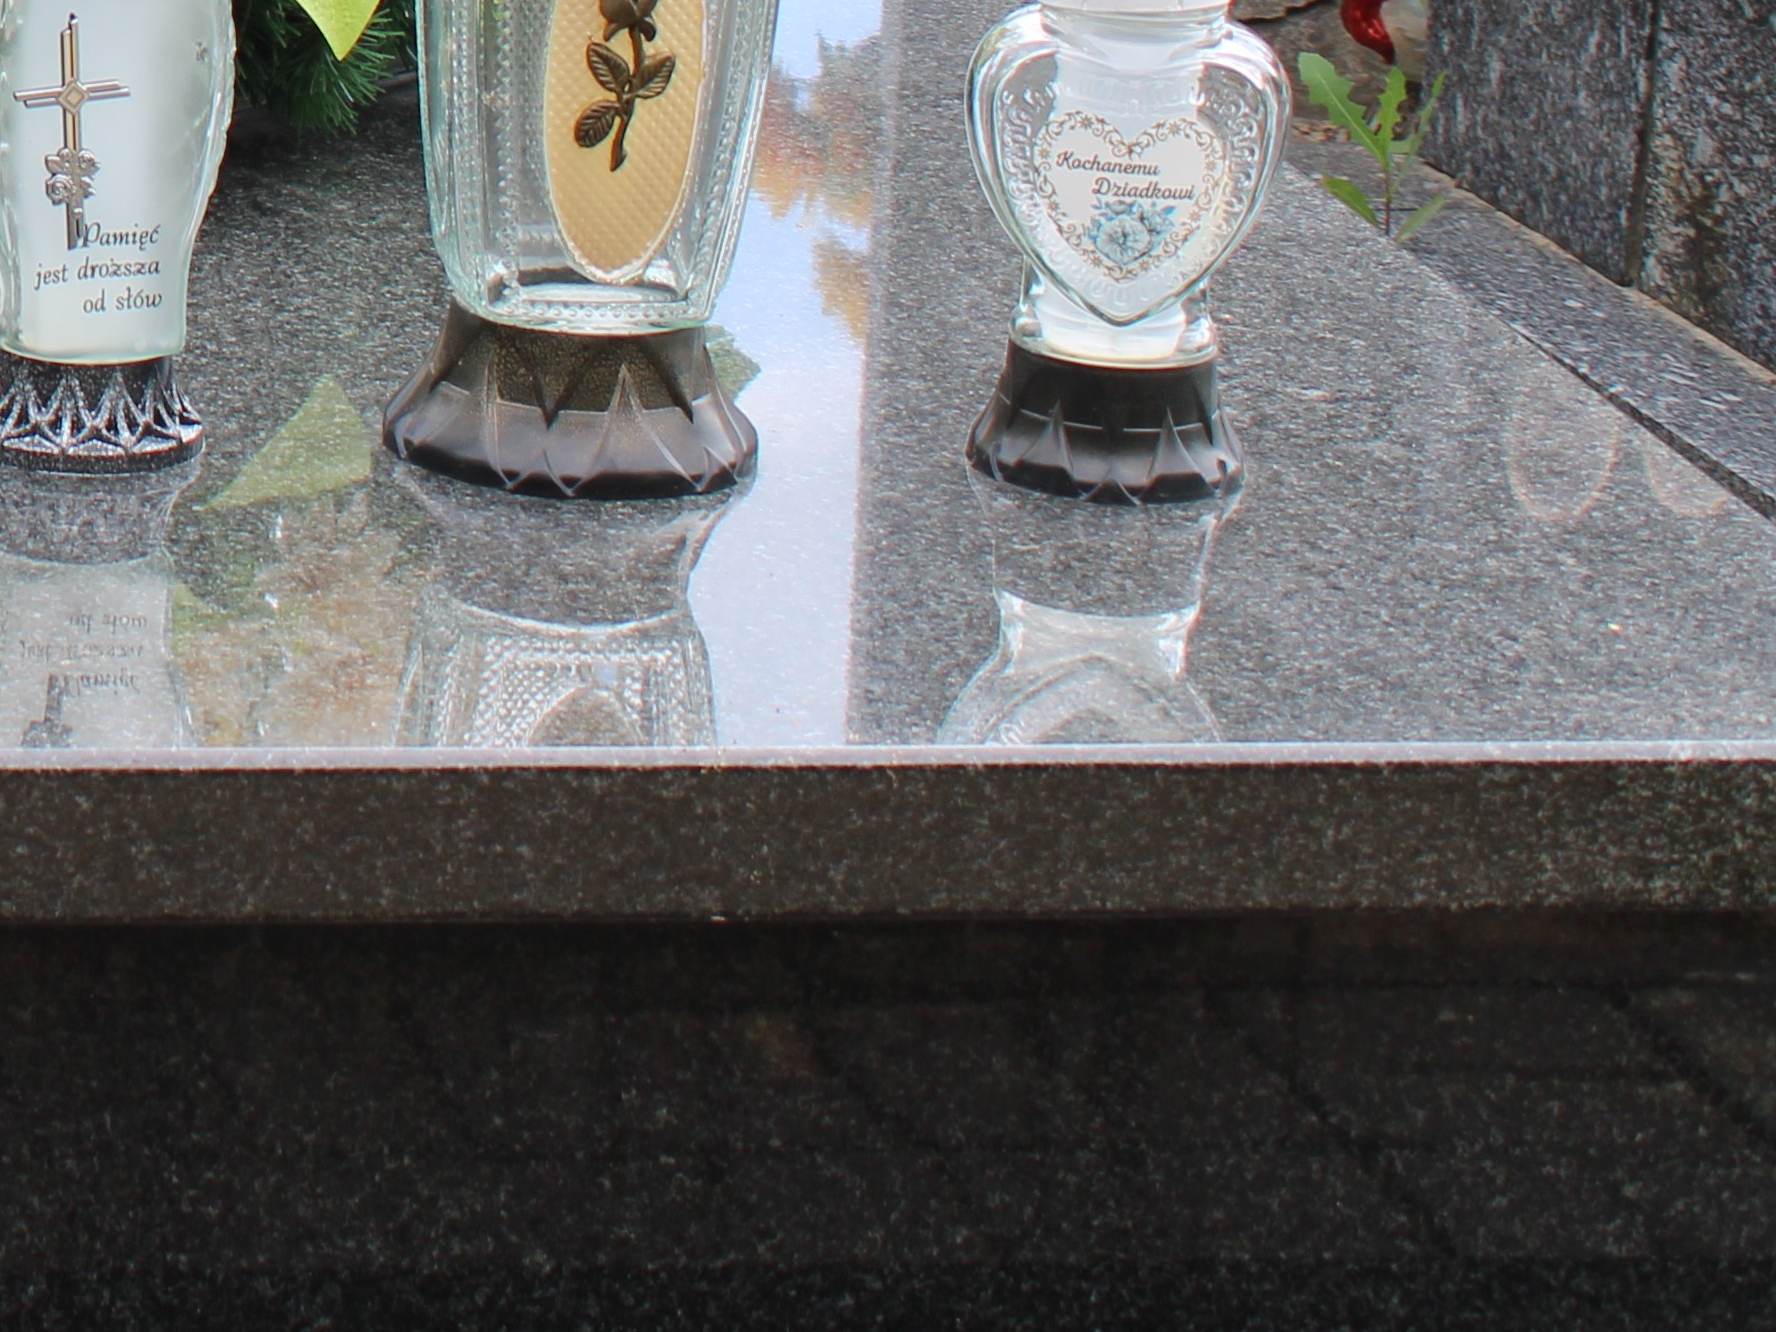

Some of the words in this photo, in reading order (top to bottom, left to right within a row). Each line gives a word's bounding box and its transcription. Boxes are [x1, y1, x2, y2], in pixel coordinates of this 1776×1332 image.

[1055, 149, 1161, 176] Kochanemu
[1091, 176, 1196, 201] Dziadkowi
[79, 221, 162, 251] Pamięć
[34, 262, 69, 291] jest
[76, 255, 162, 281] droższa
[82, 288, 108, 314] od
[114, 285, 164, 311] słów
